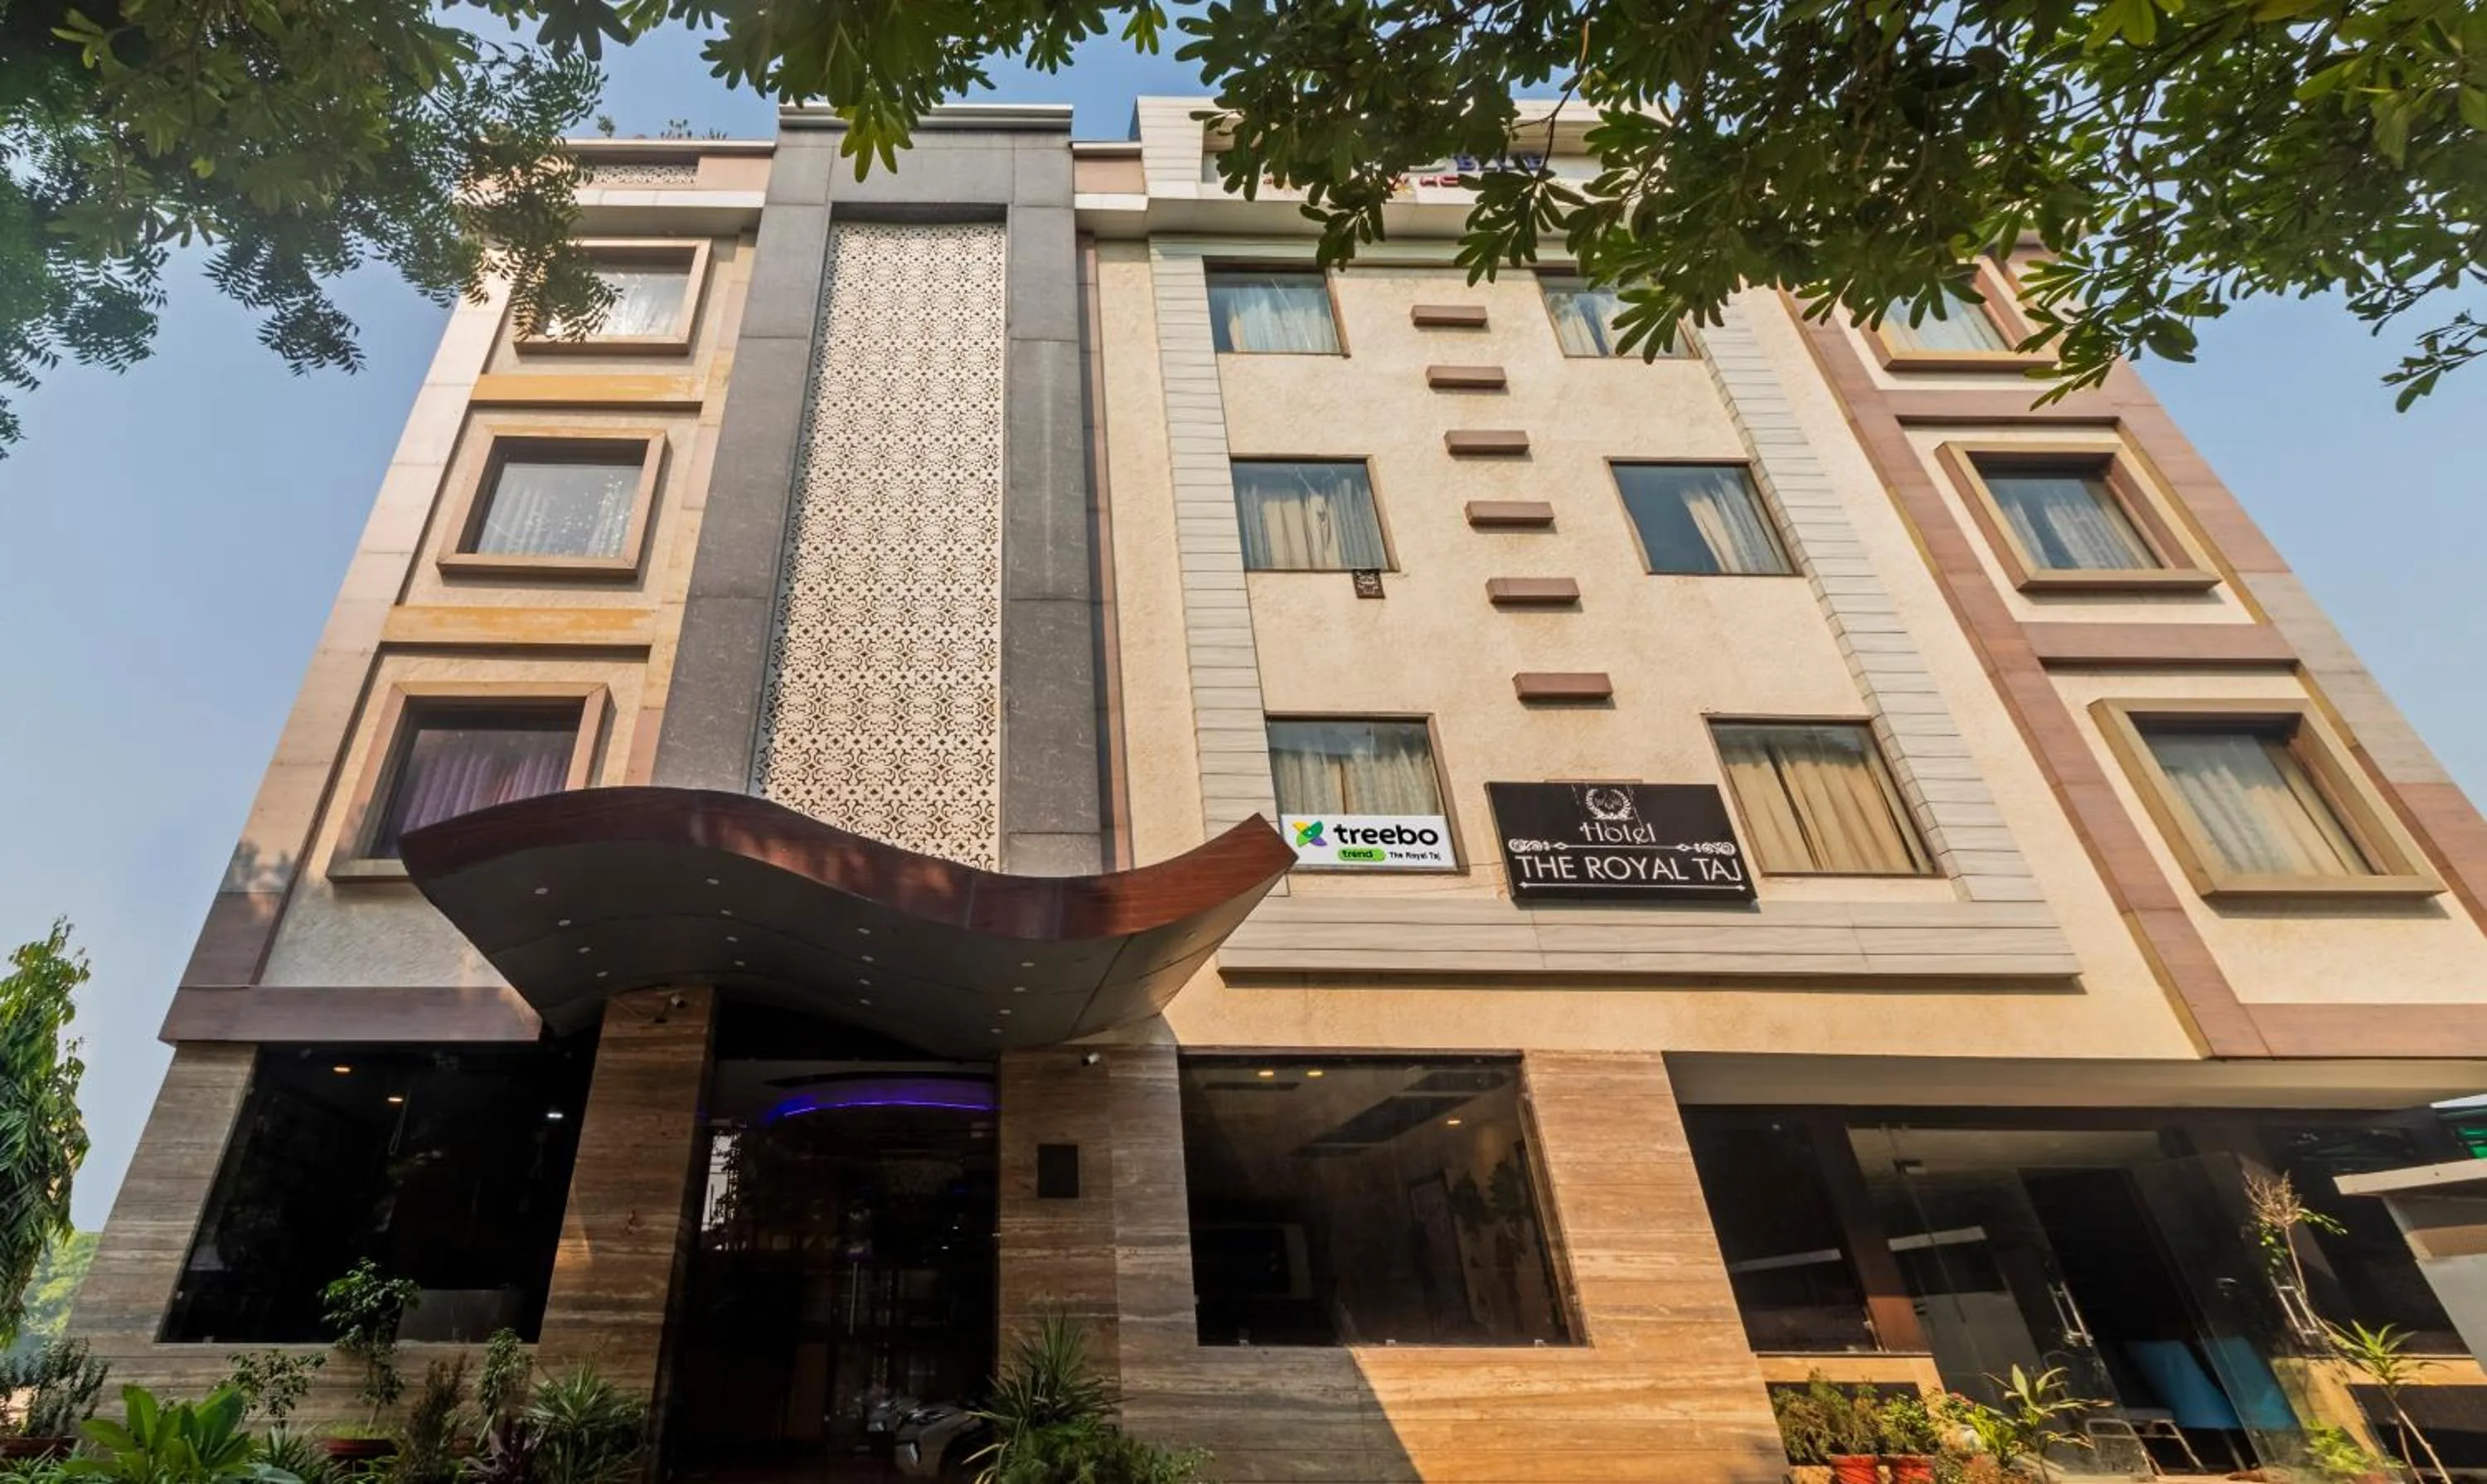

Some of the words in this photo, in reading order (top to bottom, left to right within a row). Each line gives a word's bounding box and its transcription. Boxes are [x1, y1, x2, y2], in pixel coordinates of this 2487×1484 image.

[1334, 823, 1439, 846] treebo
[1579, 822, 1656, 844] Hotel
[1343, 850, 1374, 859] trend
[1405, 851, 1428, 861] Royal
[1429, 852, 1441, 861] Taj
[1515, 855, 1578, 879] THE
[1584, 856, 1690, 880] ROYAL
[1692, 858, 1743, 881] TAJ
